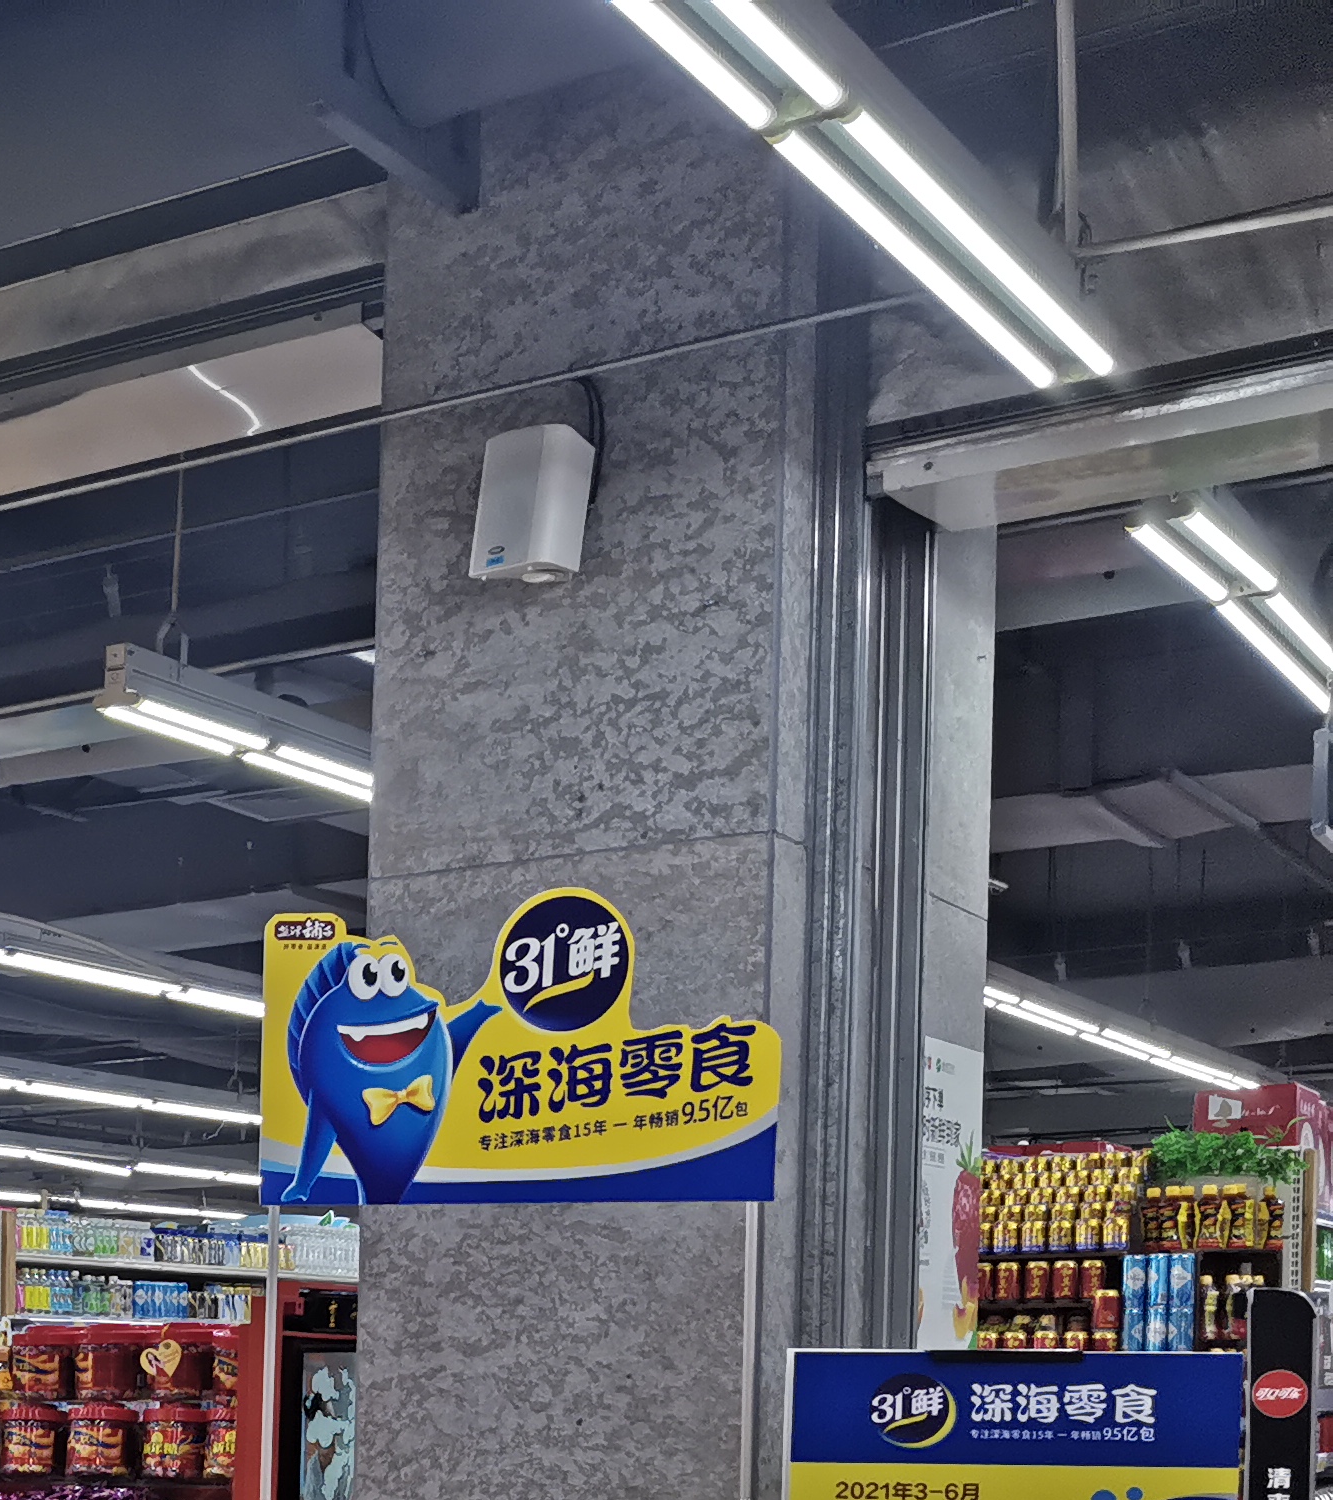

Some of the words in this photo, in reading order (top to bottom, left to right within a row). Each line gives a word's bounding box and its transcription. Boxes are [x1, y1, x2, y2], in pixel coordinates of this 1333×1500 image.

[477, 1022, 755, 1125] 深海零食
[477, 1119, 608, 1152] 专注深海零食15年
[969, 1382, 1158, 1425] 深海零食
[1255, 1386, 1304, 1401] 可口可乐
